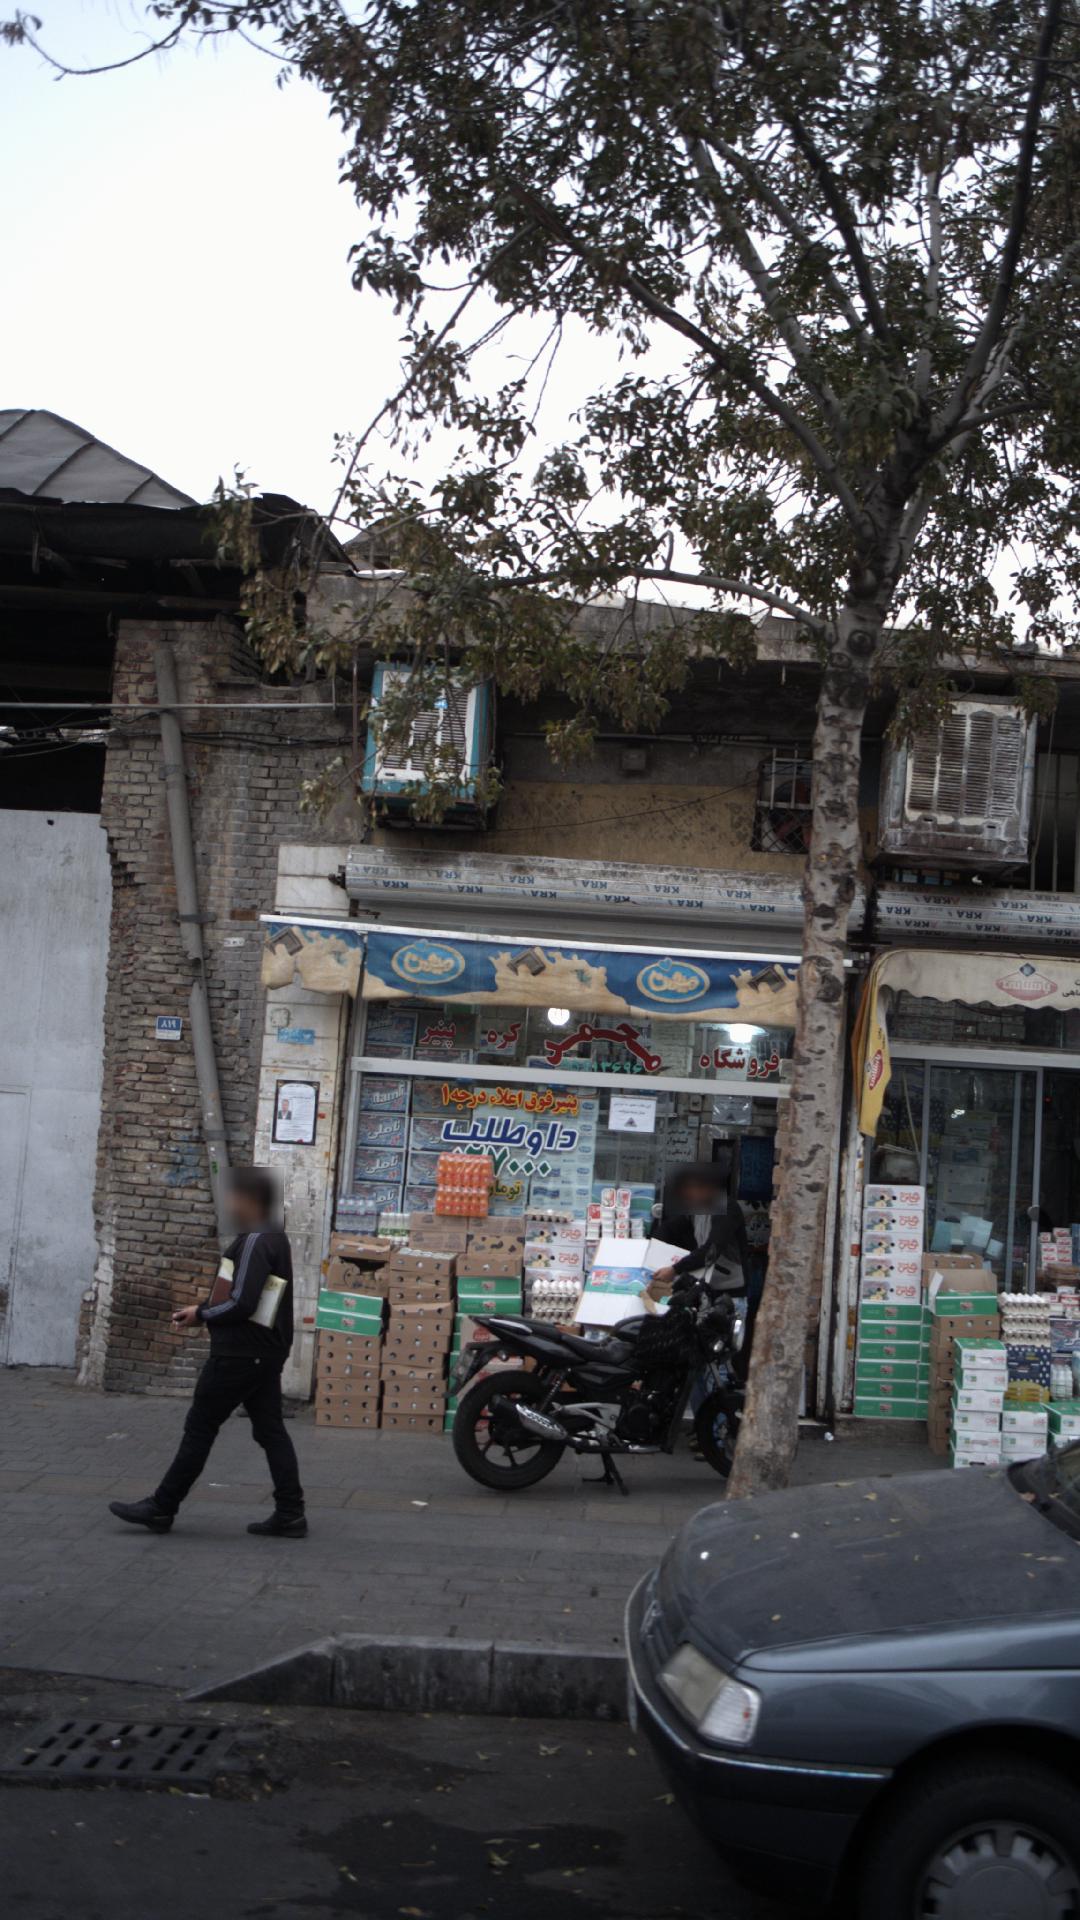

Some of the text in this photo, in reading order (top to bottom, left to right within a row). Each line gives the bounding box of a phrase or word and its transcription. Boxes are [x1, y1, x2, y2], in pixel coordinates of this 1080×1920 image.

[418, 1019, 456, 1049] پنیر
[486, 1023, 522, 1050] کره
[698, 1045, 781, 1078] فروشگاه
[449, 1089, 488, 1110] درجه
[523, 1090, 553, 1112] فوق
[551, 1094, 579, 1115] پنیر
[441, 1116, 579, 1159] داوطلب
